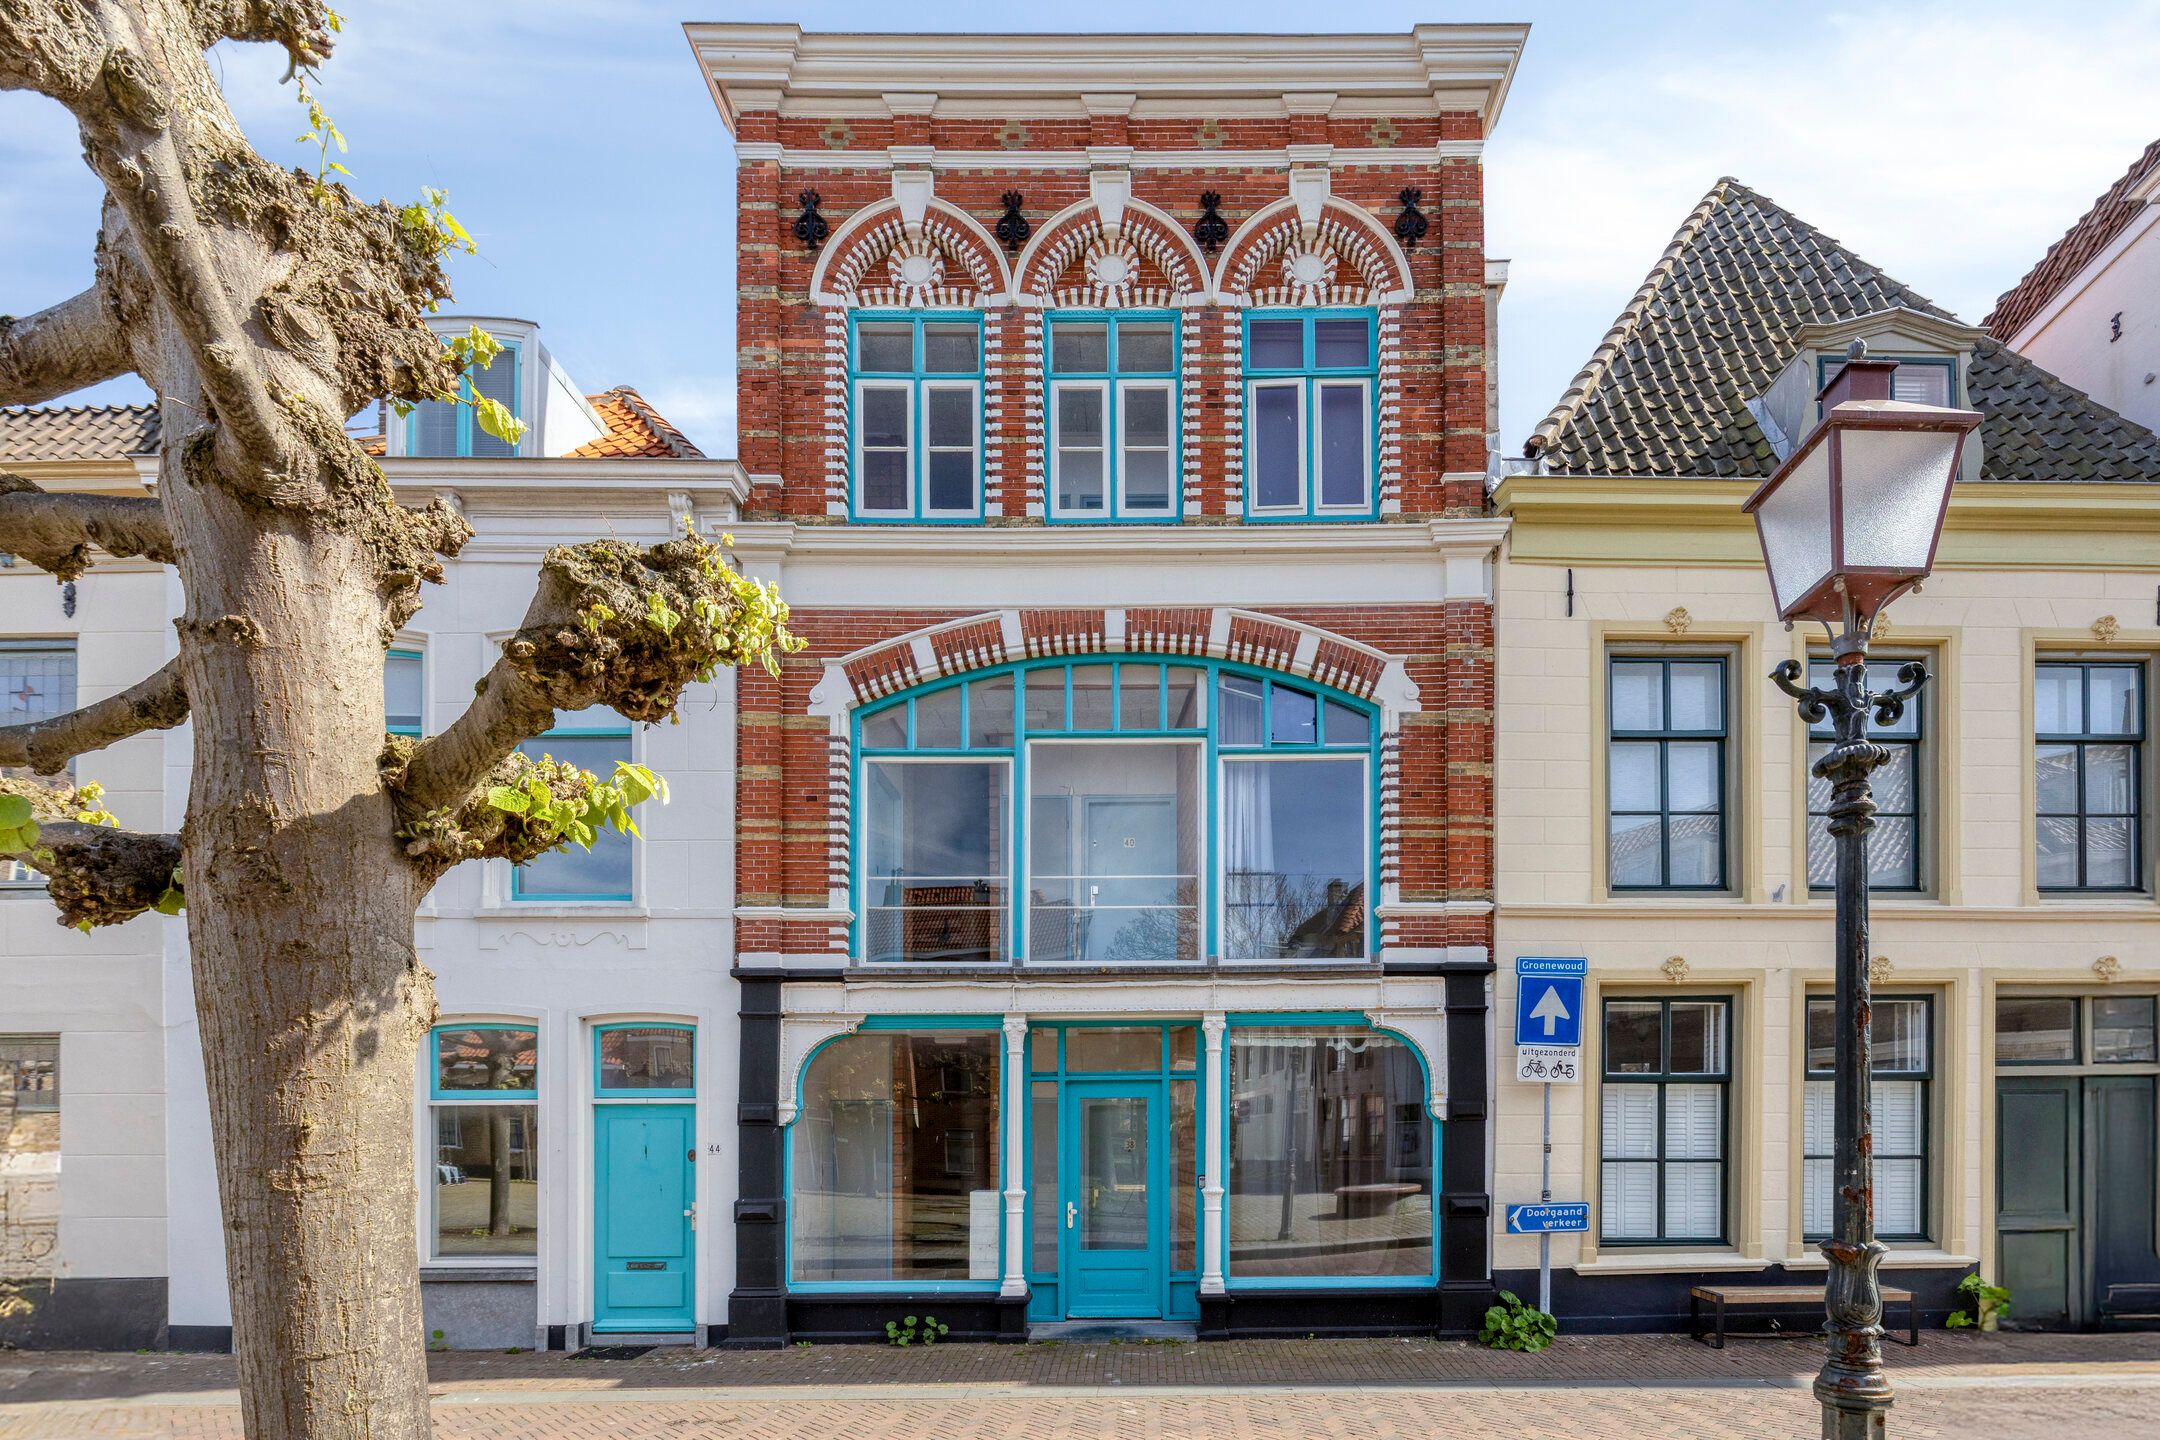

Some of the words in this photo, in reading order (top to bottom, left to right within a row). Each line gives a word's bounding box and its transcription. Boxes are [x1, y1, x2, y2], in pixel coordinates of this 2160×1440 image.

[1522, 961, 1583, 970] Groenewoud
[1522, 1048, 1576, 1058] uitgezonderd
[709, 1144, 721, 1154] 44
[1526, 1207, 1583, 1218] Doorgaand
[1542, 1219, 1582, 1228] verkeer
